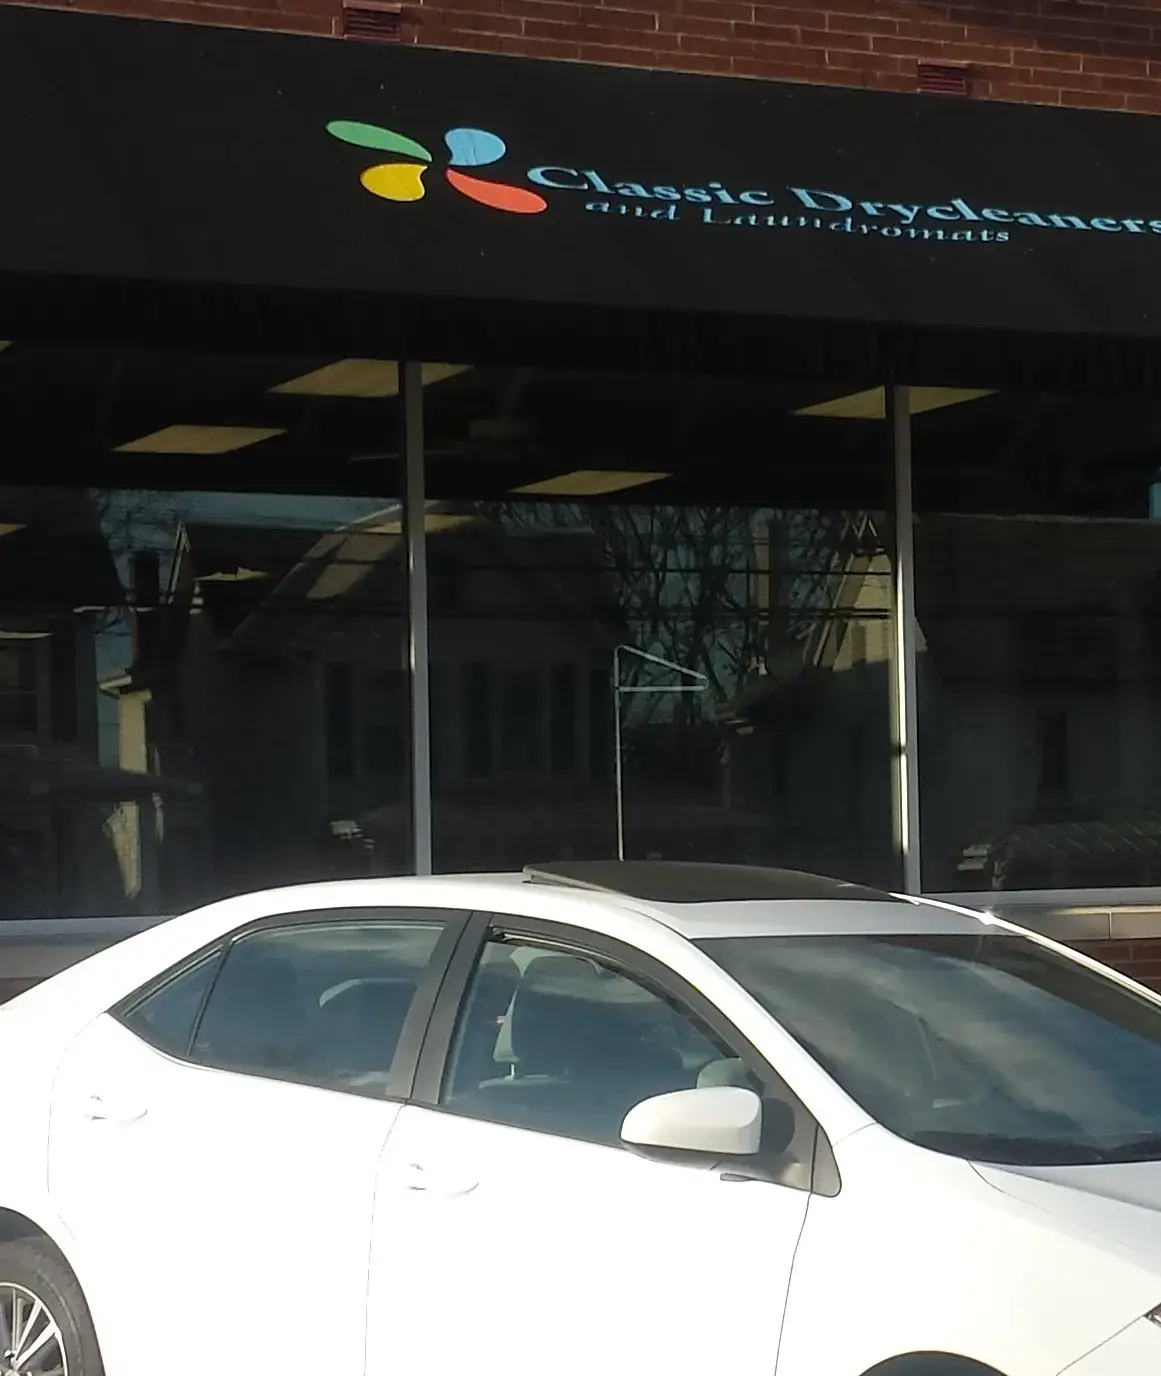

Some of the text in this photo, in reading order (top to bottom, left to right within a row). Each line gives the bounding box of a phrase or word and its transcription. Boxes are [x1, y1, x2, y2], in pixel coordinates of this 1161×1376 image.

[526, 165, 775, 205] Classic
[585, 201, 1010, 242] and Laundromats
